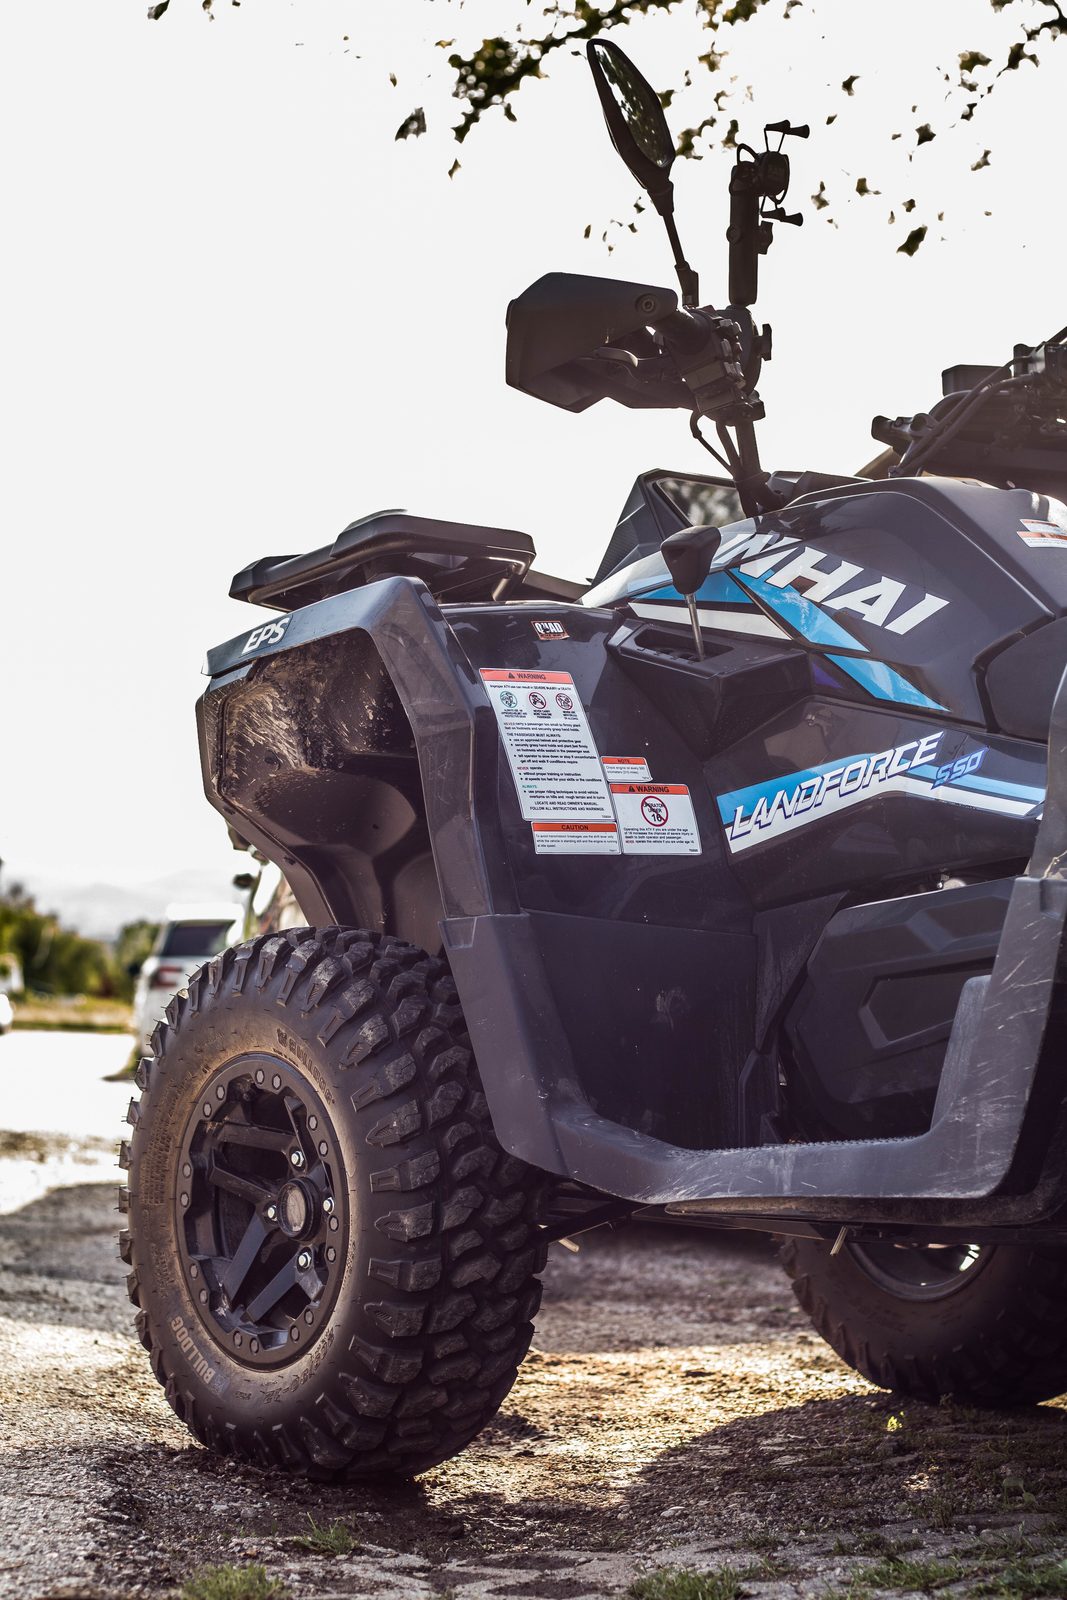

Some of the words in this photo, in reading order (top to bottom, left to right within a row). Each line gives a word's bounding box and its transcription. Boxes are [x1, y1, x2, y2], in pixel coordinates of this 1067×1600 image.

[241, 617, 290, 654] EPS
[534, 622, 564, 634] QUAD
[729, 730, 945, 841] LANDFORCE
[652, 814, 662, 822] 16
[171, 1316, 216, 1384] BULLDOG
